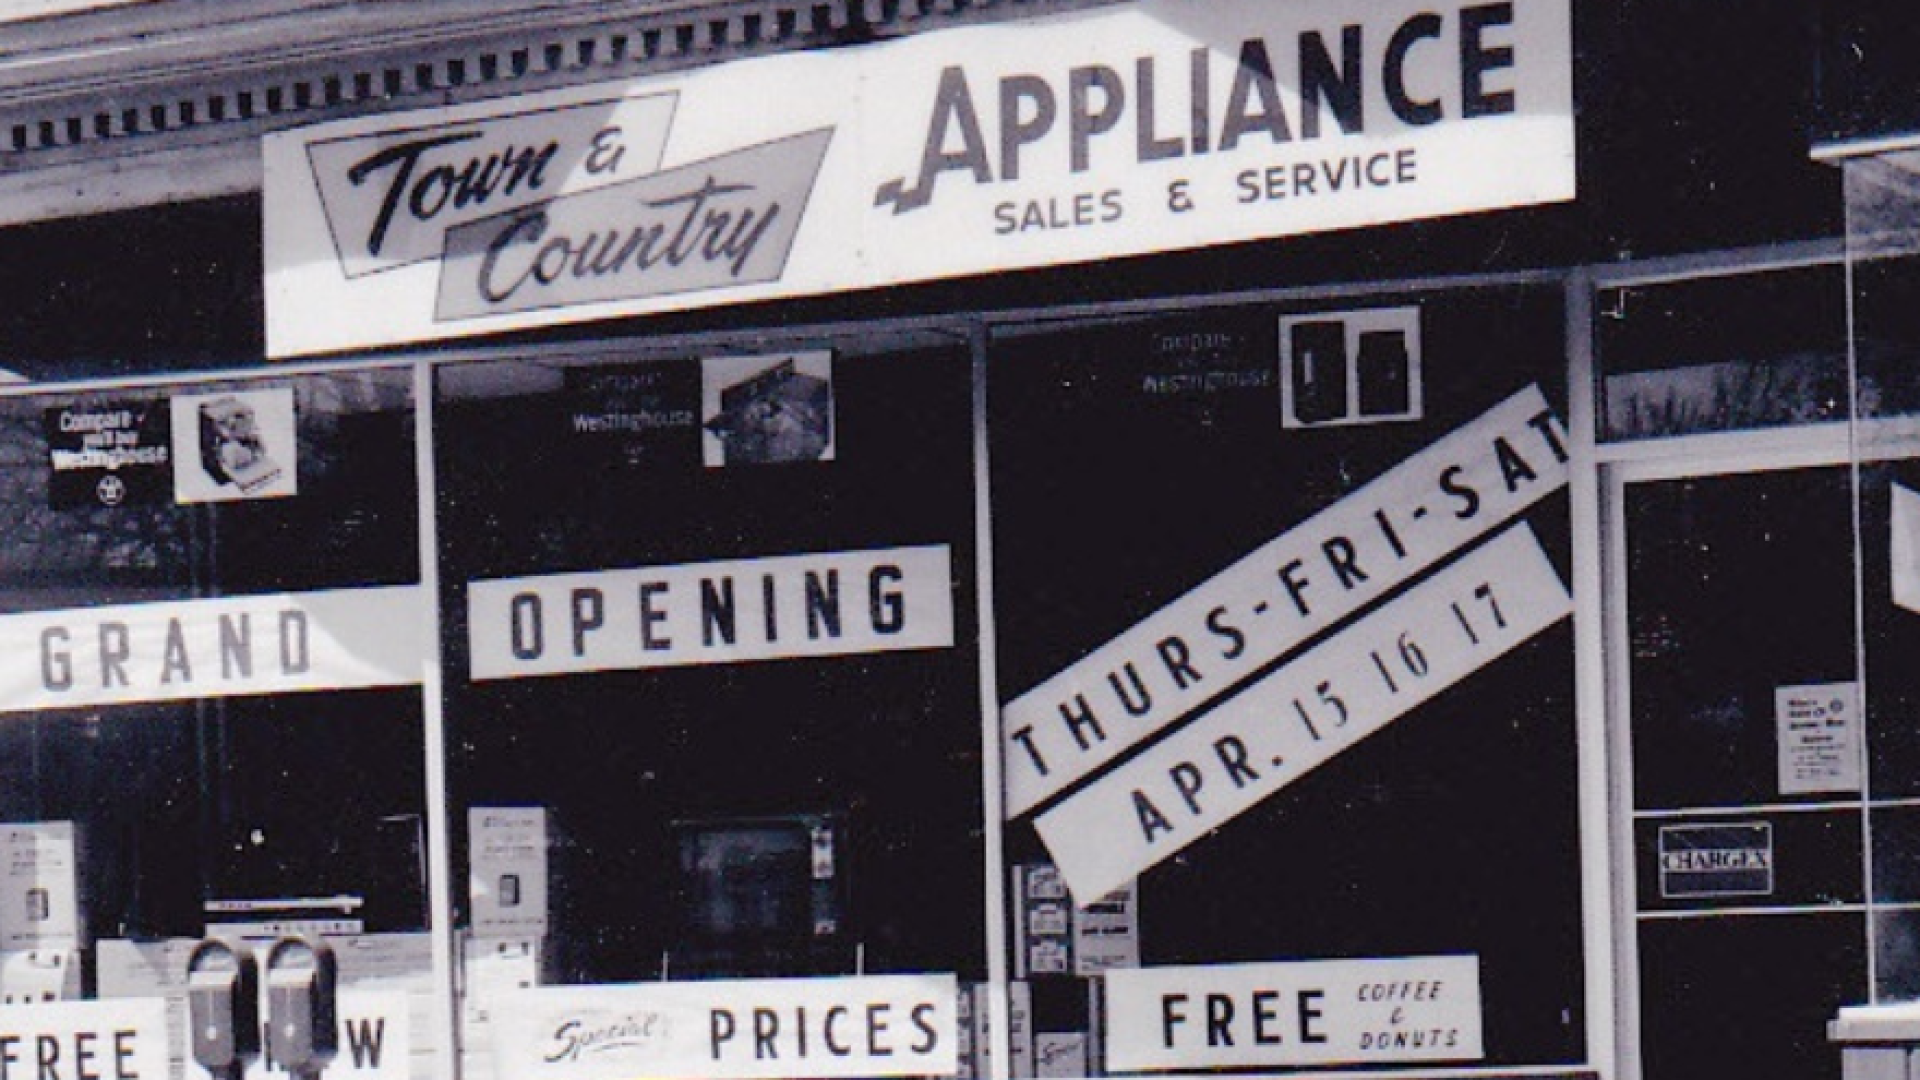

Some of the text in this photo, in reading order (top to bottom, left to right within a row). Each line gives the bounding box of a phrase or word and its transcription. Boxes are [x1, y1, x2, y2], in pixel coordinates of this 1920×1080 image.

[873, 3, 1516, 215] APPLIANCE
[347, 126, 625, 256] Town &
[993, 149, 1417, 235] SALES & SERVICE
[478, 174, 781, 303] Country
[40, 608, 311, 692] GRAND
[509, 563, 906, 661] OPENING
[1131, 582, 1508, 842] APR. 15 16 17
[1661, 850, 1767, 870] CHARGEX
[709, 1003, 938, 1059] PRICES
[1161, 989, 1329, 1049] FREE
[1357, 980, 1444, 1002] COFFEE
[0, 1029, 141, 1080] FREE
[1358, 1028, 1460, 1050] DONUTS
